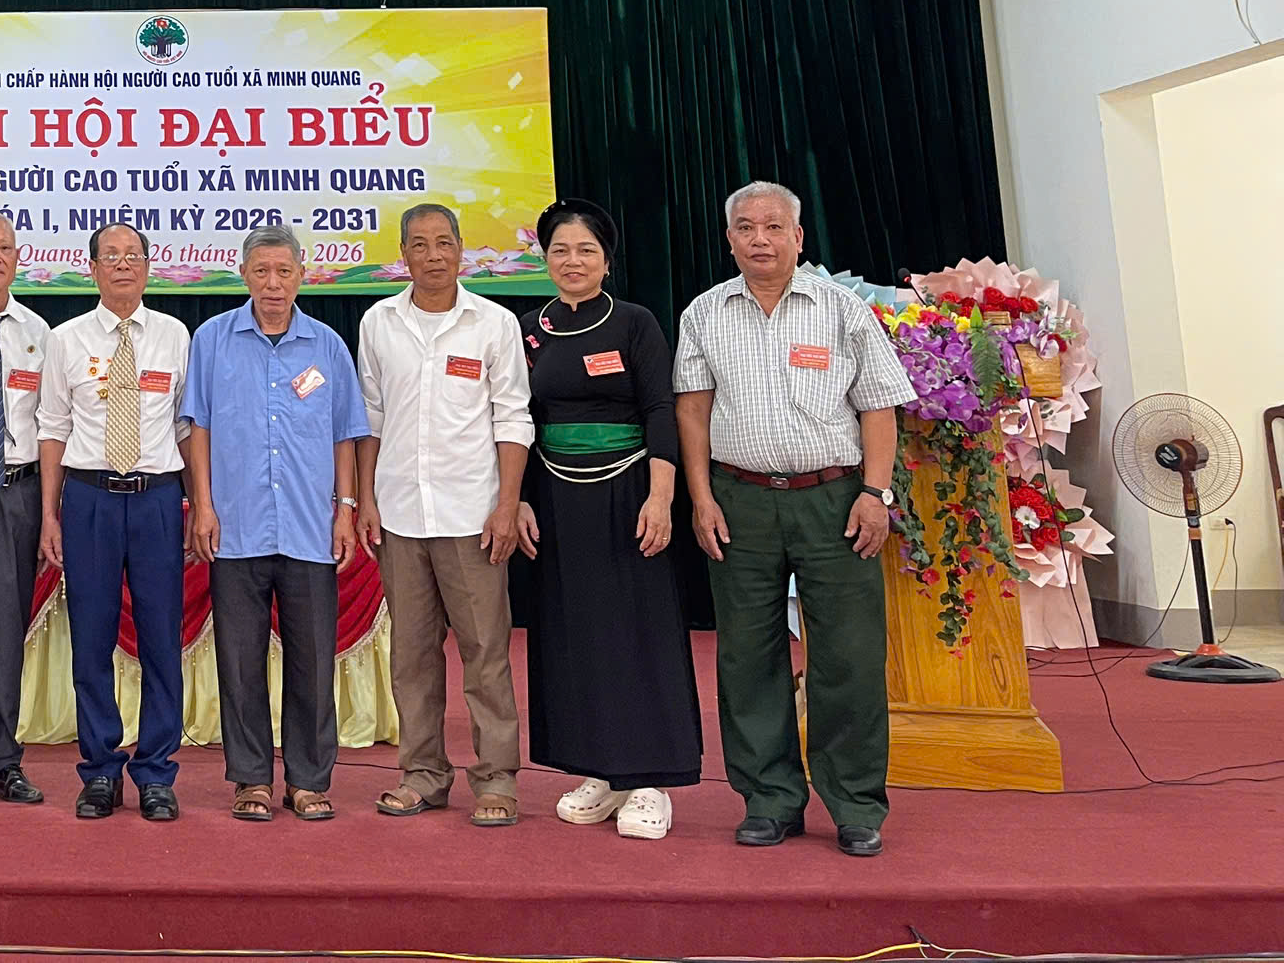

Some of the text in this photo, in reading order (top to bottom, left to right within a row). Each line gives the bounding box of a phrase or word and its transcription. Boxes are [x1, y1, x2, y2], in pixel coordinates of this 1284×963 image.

[6, 67, 44, 88] CHẤP
[49, 69, 89, 88] HÀNH
[93, 69, 118, 91] HỘI
[122, 68, 168, 88] NGƯỜI
[172, 72, 201, 88] CAO
[205, 65, 238, 87] TUỔI
[242, 68, 263, 87] XÃ
[267, 71, 306, 87] MINH
[311, 70, 361, 88] QUANG
[30, 97, 138, 158] HỘI
[159, 108, 267, 158] ĐẠI
[288, 82, 433, 147] BIỂU
[64, 169, 117, 192] CAO
[126, 160, 188, 192] TUỔI
[198, 164, 236, 192] XÃ
[245, 169, 320, 192] MINH
[330, 168, 426, 194] QUANG
[43, 208, 59, 234] I,
[170, 204, 205, 231] KỲ
[214, 208, 283, 231] 2026
[312, 208, 378, 231] 2031
[18, 244, 87, 267] Quang,
[148, 244, 173, 262] 26
[179, 244, 237, 267] tháng
[314, 244, 363, 262] 2026
